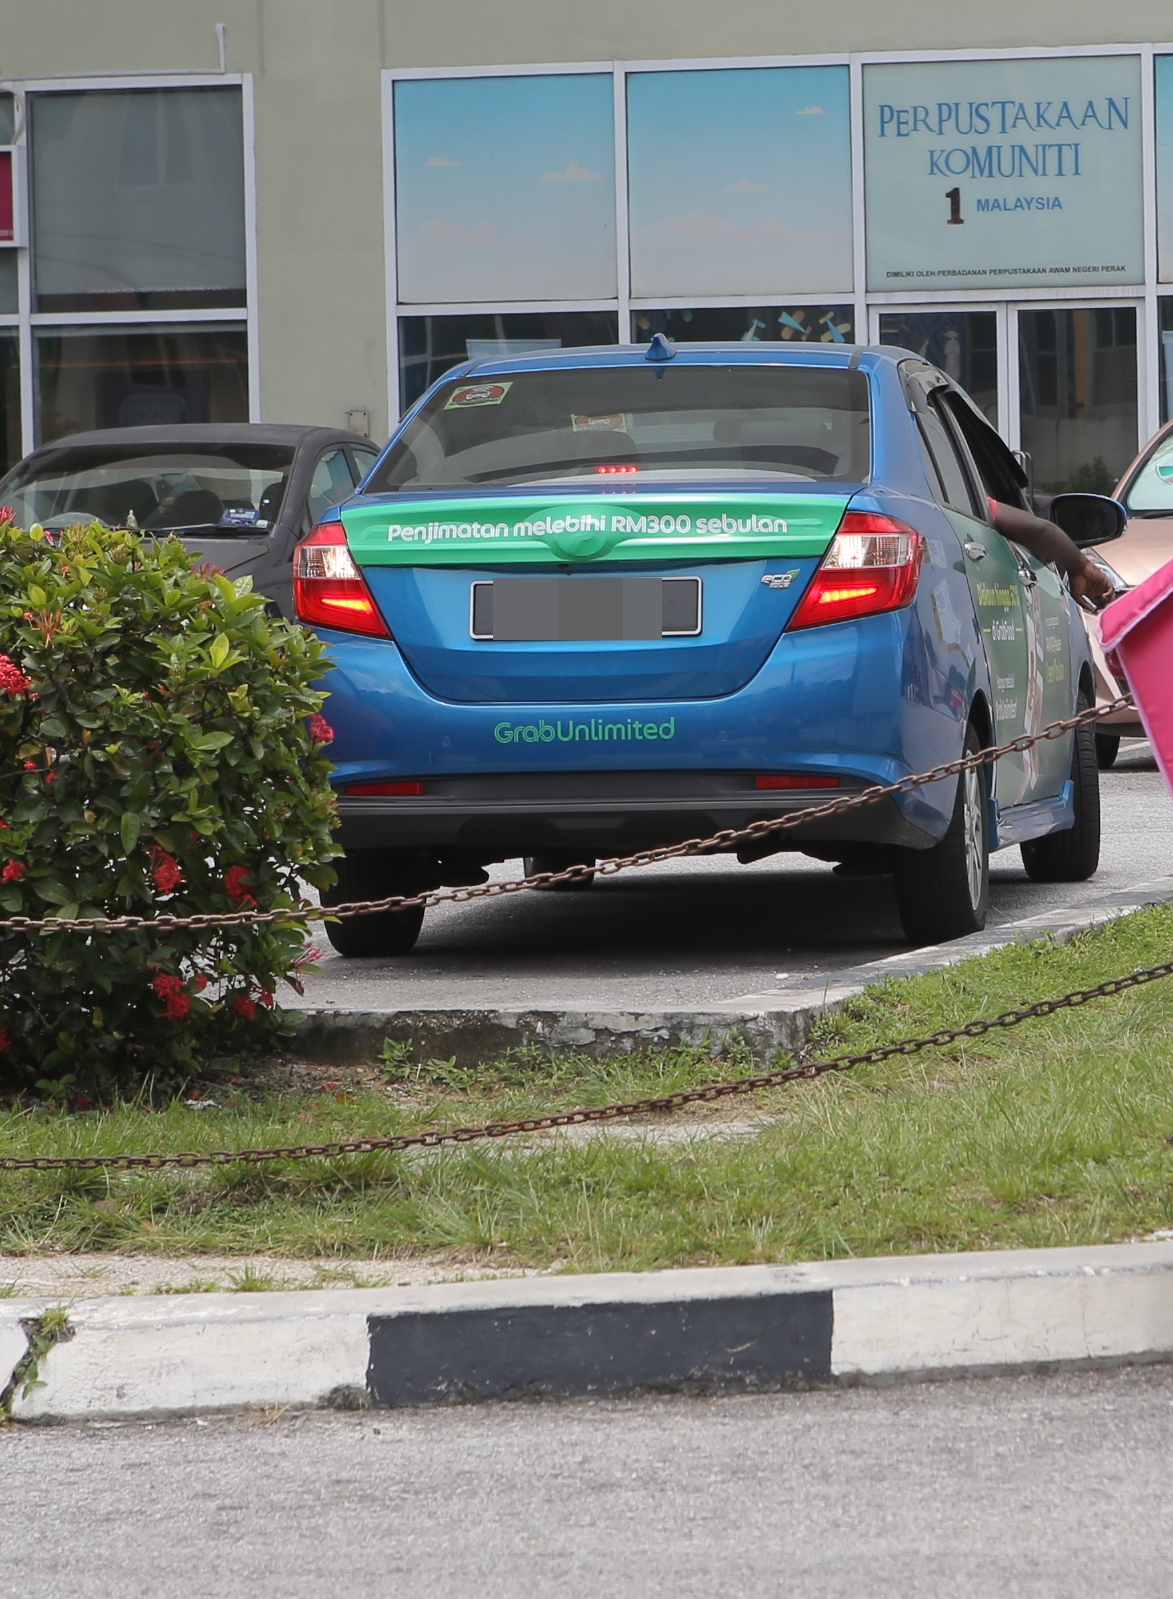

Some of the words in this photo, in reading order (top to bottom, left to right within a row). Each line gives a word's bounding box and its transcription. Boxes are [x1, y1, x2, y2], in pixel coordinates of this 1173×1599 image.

[878, 97, 1130, 138] PERPUSTAKAAN
[928, 143, 1082, 179] KOMUNITI
[945, 187, 964, 225] 1
[976, 197, 1062, 212] MALAYSIA
[989, 268, 1047, 276] PERPUSTAKAAN
[1048, 266, 1071, 274] AWAM
[388, 522, 509, 545] Penjimatan
[513, 514, 607, 537] melebihi
[611, 514, 691, 534] RM300
[696, 513, 787, 534] sebulan
[494, 717, 676, 743] GrabUnlimited
